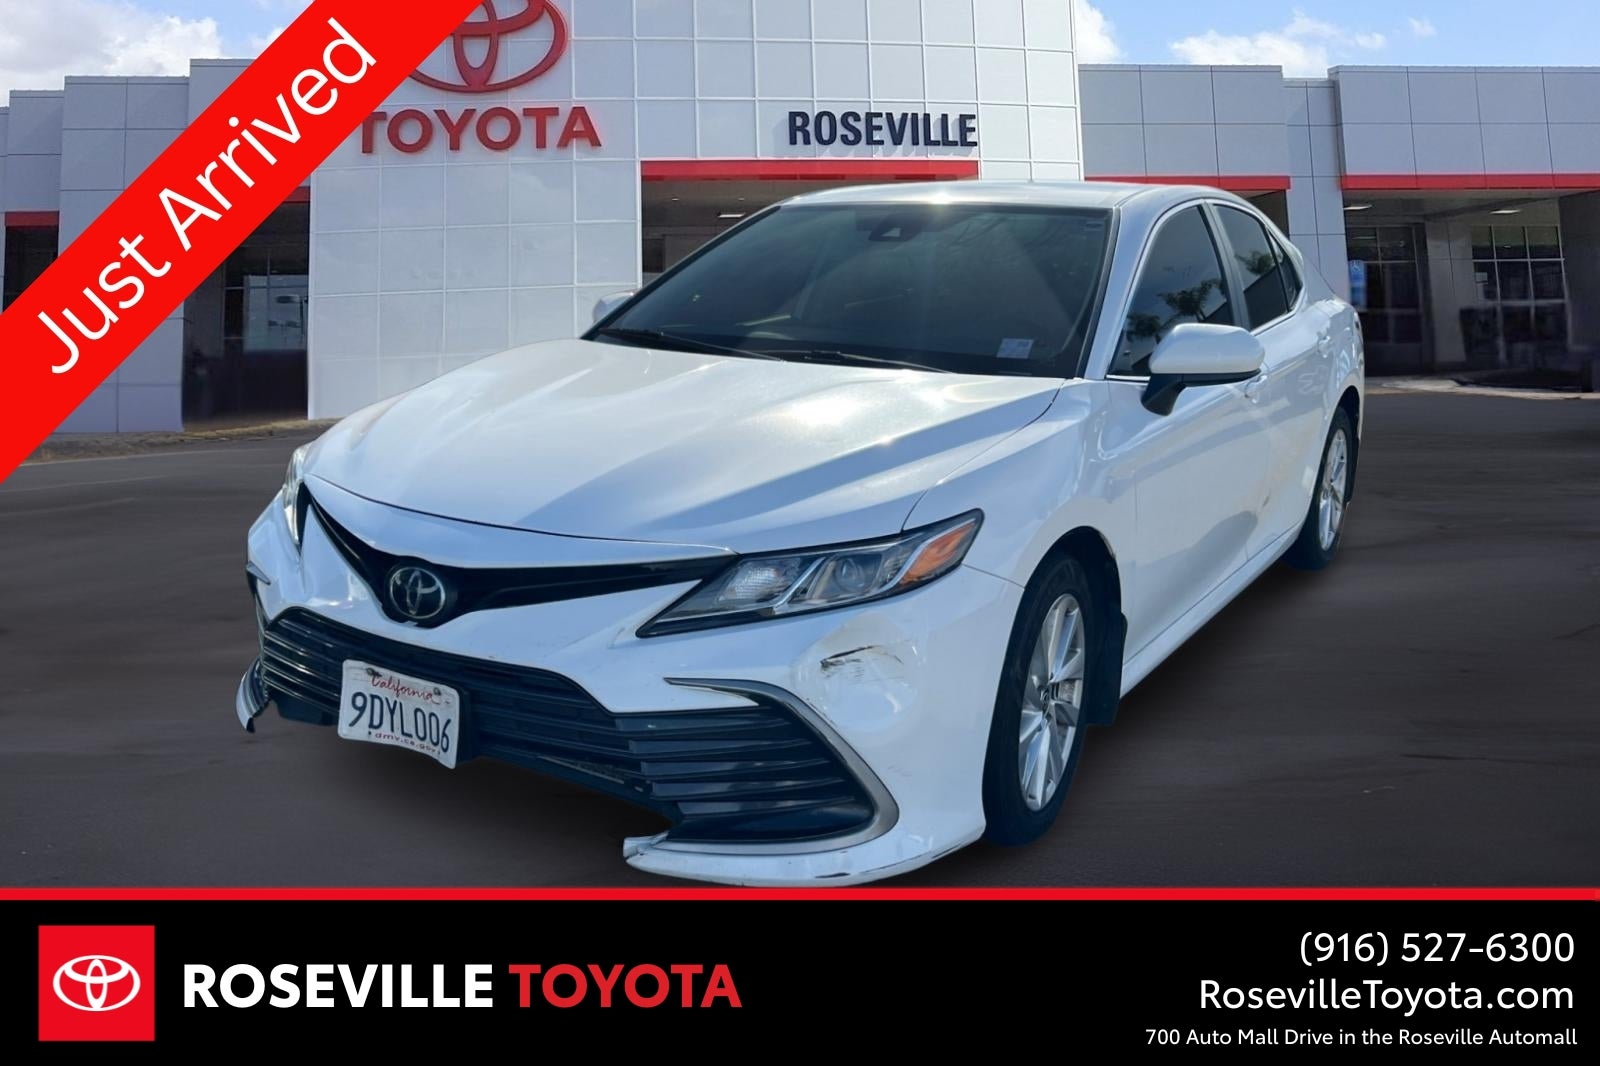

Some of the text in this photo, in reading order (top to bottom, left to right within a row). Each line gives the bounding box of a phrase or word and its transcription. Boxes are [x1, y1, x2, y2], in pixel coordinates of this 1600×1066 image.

[361, 106, 602, 154] TOYOTA
[788, 110, 978, 147] ROSEVILLE
[370, 671, 440, 704] California
[348, 691, 452, 753] 9DYL006
